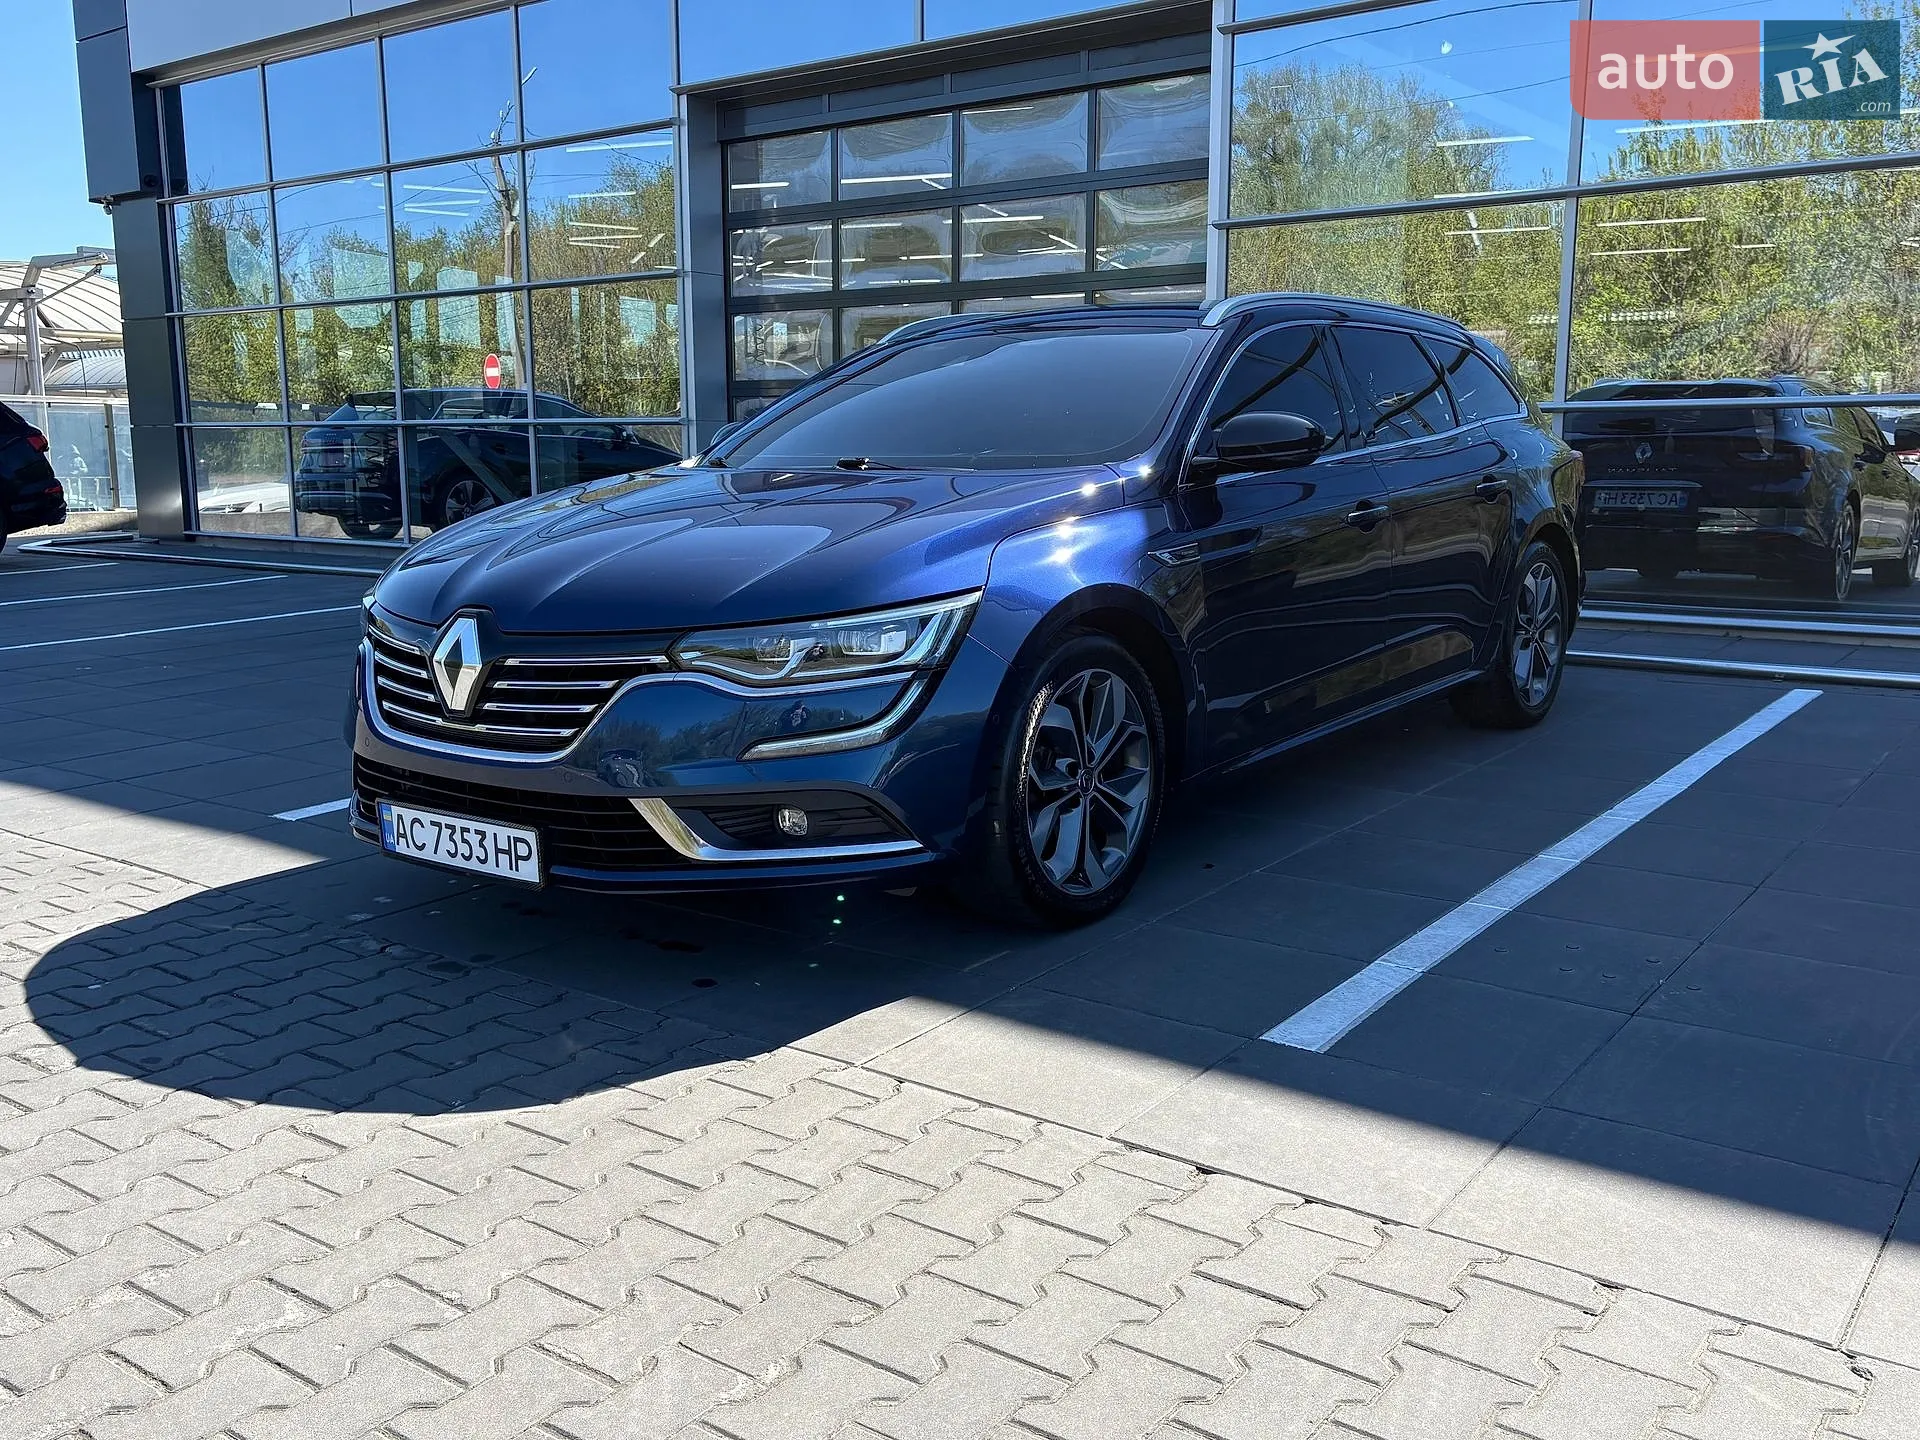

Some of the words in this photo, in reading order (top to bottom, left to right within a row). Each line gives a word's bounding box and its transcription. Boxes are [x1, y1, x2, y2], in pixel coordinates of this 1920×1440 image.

[385, 832, 394, 844] UA
[396, 814, 426, 851] AC
[430, 820, 489, 864] 7353
[492, 833, 533, 872] HP
